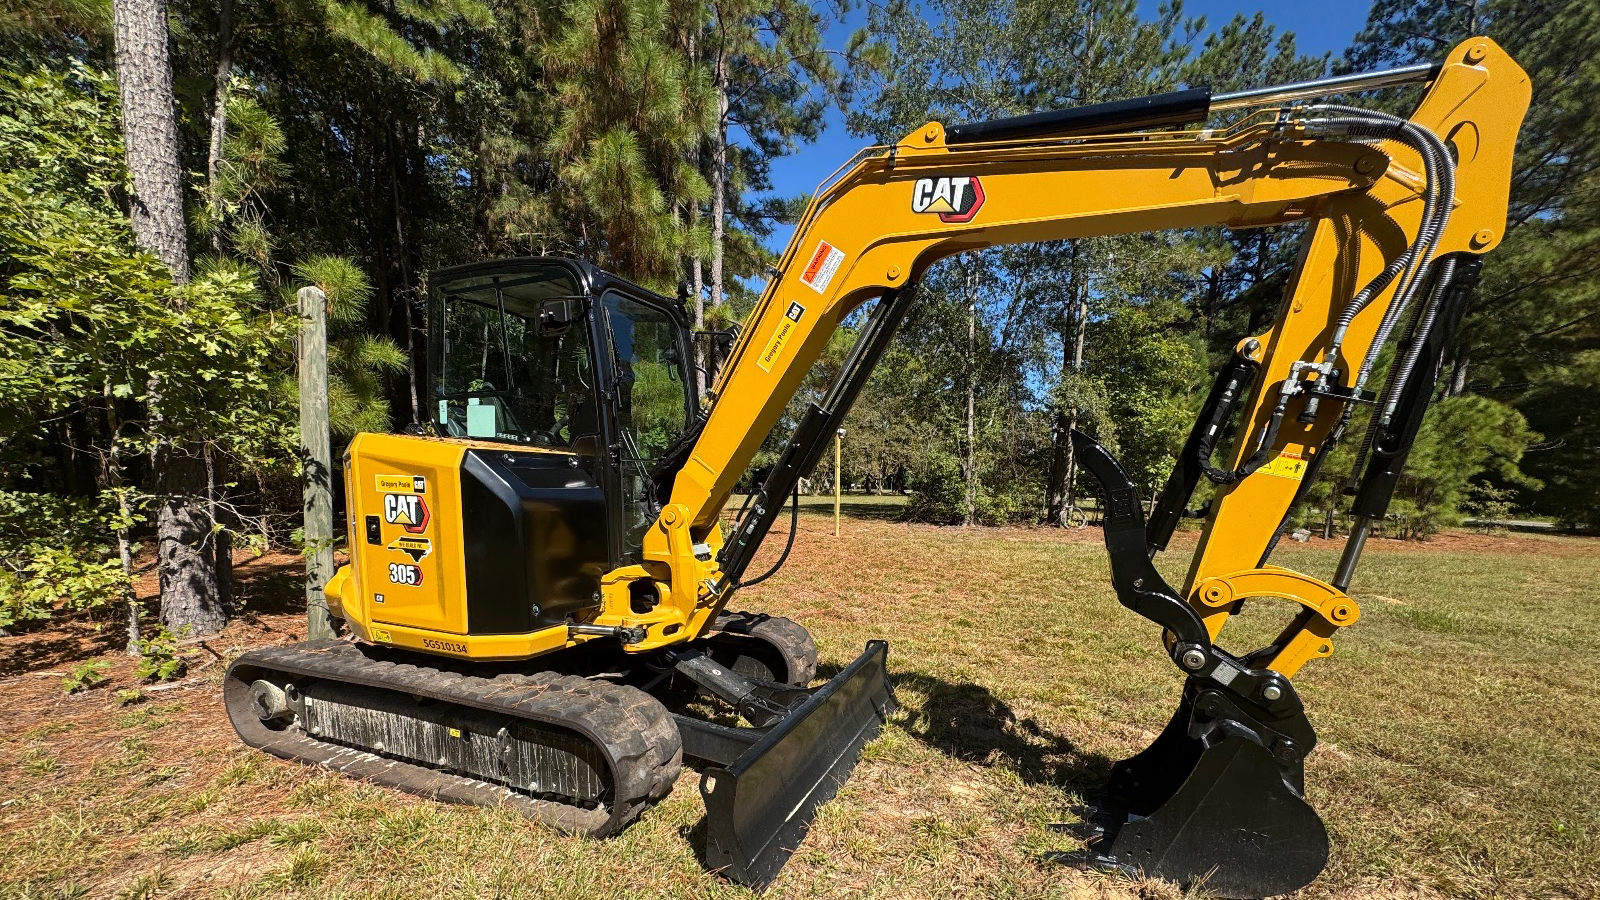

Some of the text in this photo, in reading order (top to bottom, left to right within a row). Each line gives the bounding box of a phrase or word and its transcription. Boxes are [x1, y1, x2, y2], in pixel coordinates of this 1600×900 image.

[912, 177, 970, 212] CAT
[811, 245, 827, 270] WARNING
[788, 304, 801, 320] CAT
[765, 323, 791, 362] Gregory Poole
[380, 480, 411, 488] Gregory Poole
[414, 480, 424, 490] CAT
[384, 494, 418, 525] CAT
[388, 563, 416, 584] 305
[423, 638, 468, 654] 5G510134
